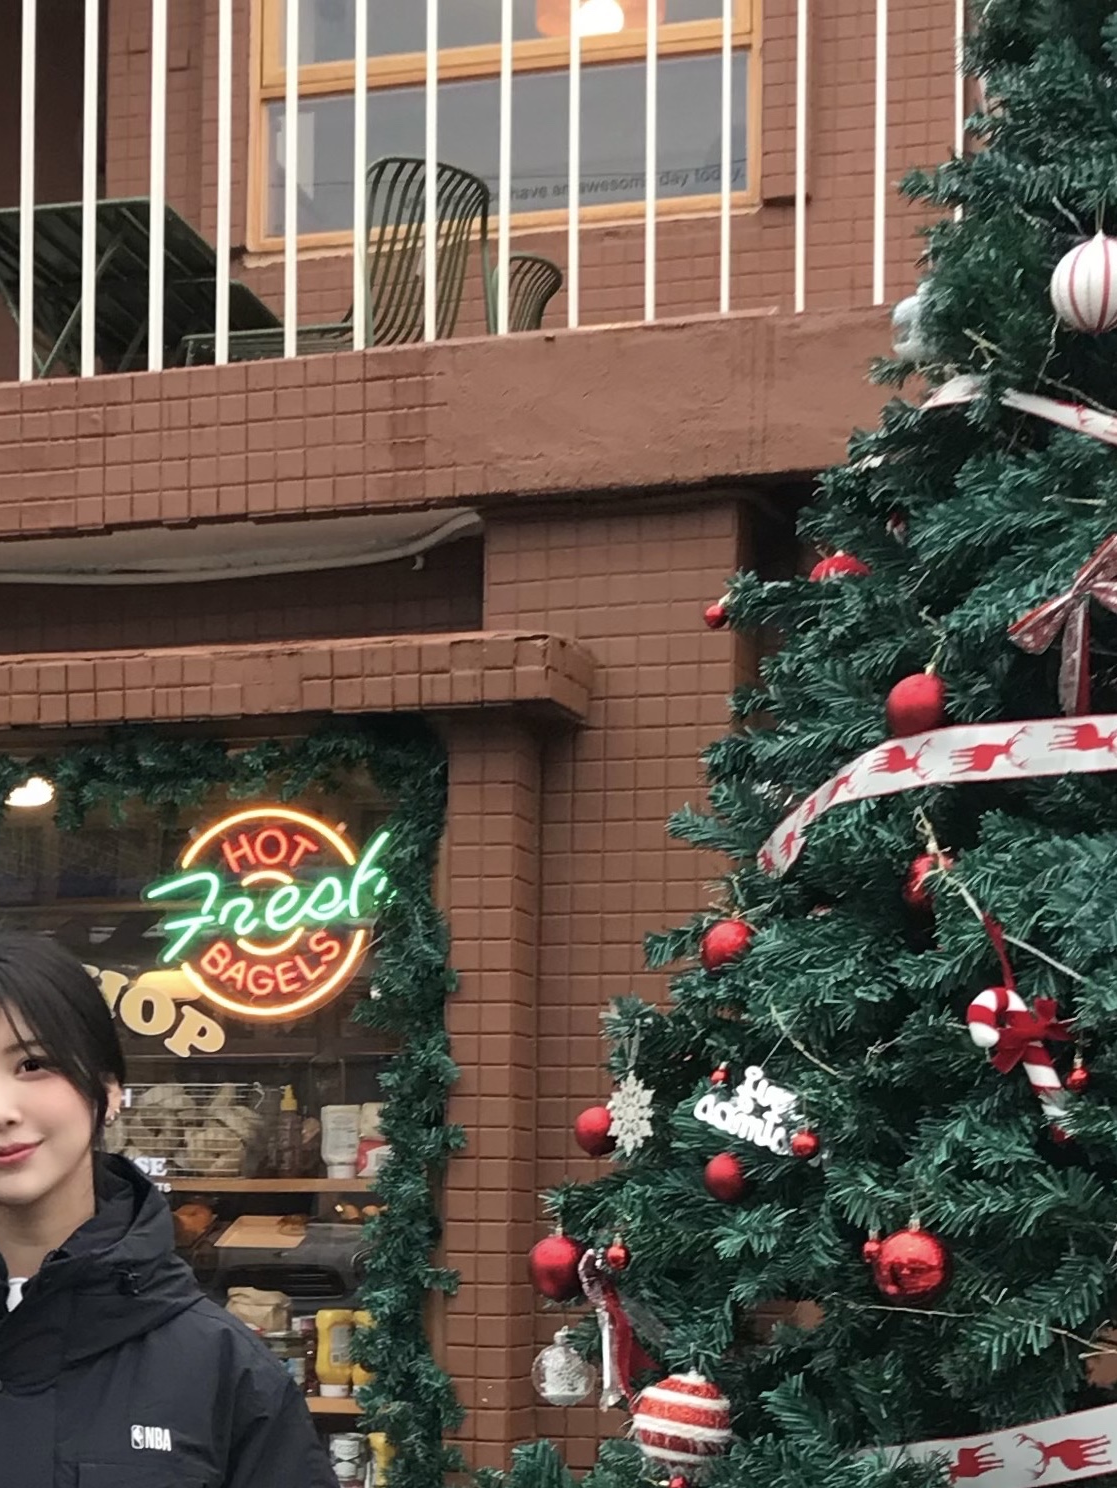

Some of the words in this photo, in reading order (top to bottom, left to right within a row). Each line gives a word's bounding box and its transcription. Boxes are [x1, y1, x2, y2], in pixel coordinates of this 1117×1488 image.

[580, 177, 646, 194] awesom
[694, 164, 746, 185] tody.
[221, 828, 319, 874] HOT
[200, 931, 341, 995] BAGELS
[144, 1426, 172, 1452] NBA
